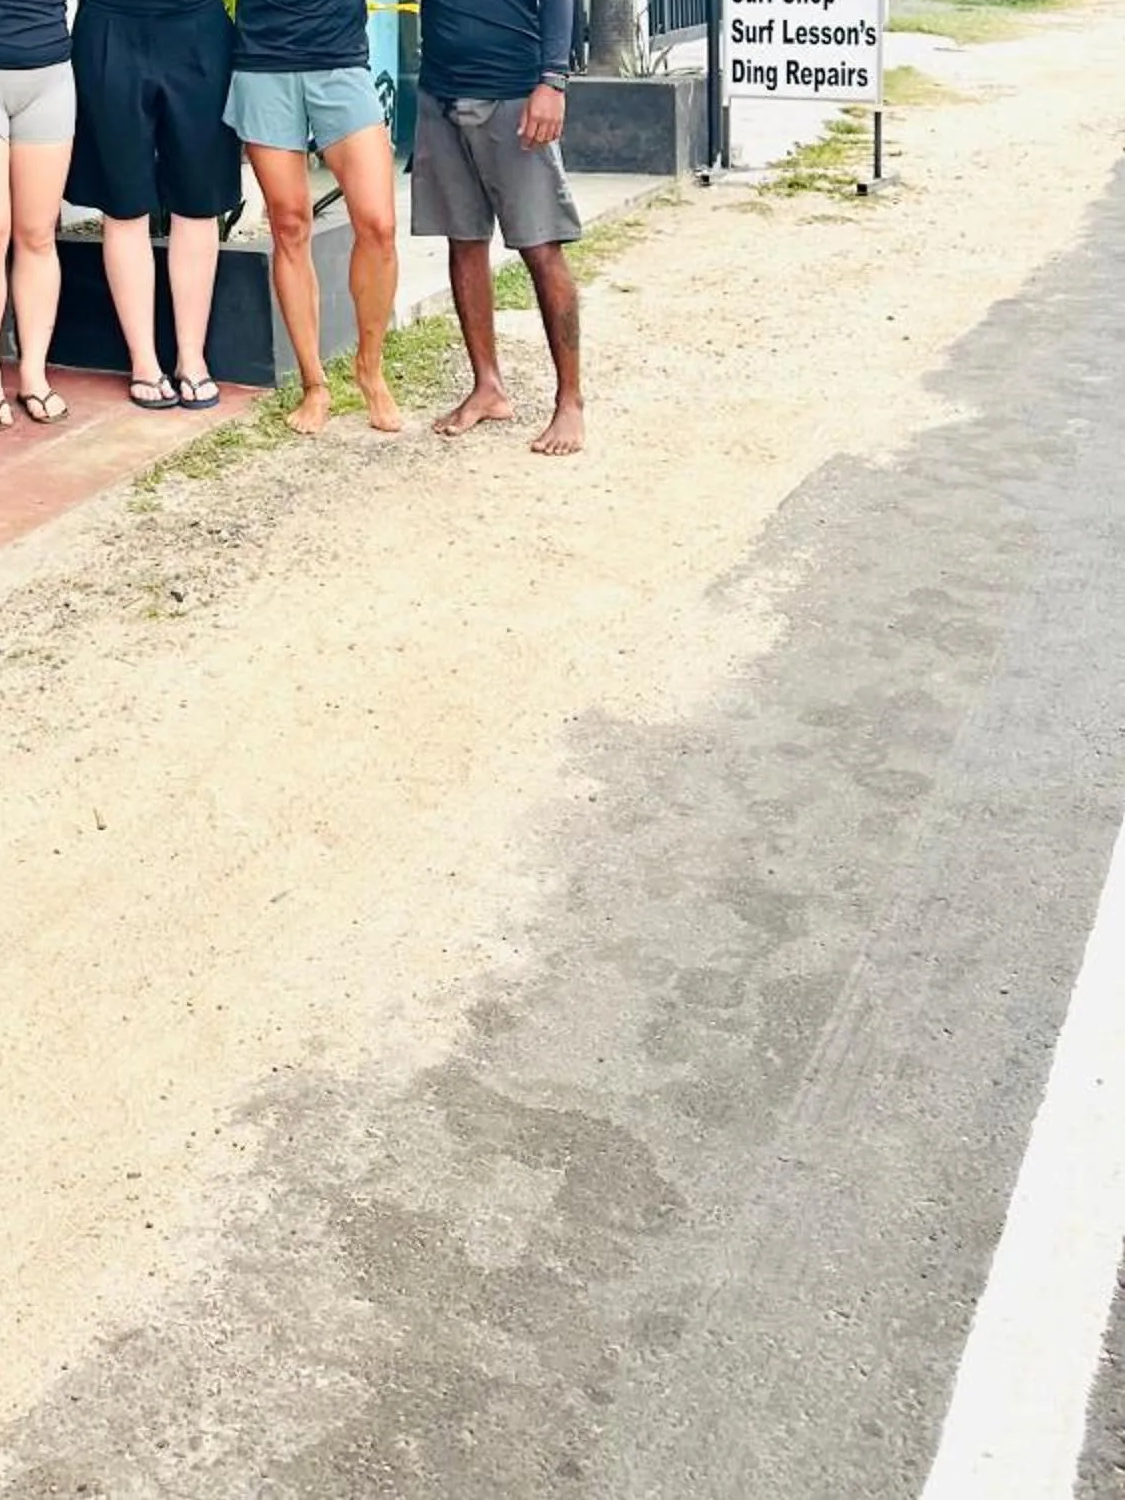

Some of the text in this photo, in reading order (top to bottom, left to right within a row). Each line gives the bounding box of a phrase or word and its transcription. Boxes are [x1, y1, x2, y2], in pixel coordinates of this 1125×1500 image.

[731, 18, 877, 46] Surf Lesson's
[731, 58, 869, 92] Ding Repairs
